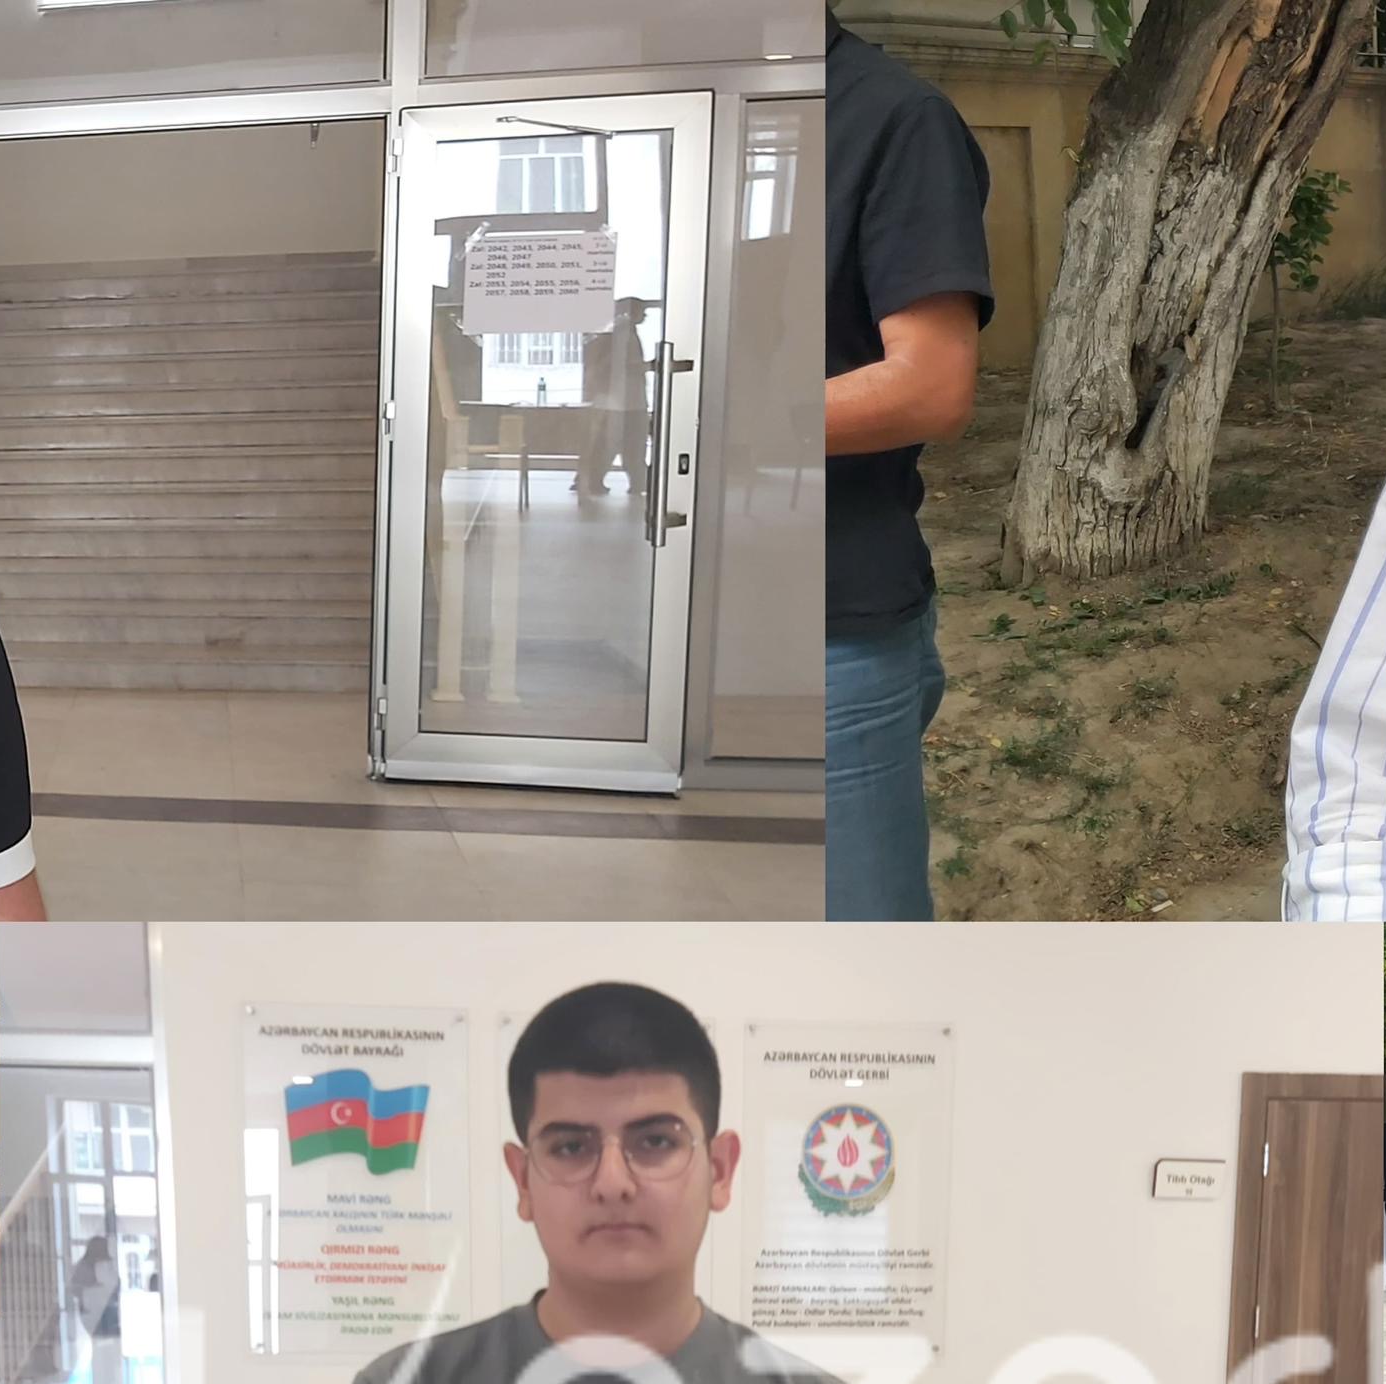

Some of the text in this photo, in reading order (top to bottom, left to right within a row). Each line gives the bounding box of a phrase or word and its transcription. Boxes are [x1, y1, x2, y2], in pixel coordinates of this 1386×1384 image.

[259, 1025, 445, 1041] AZƏRBAYCAN RESPUBLİKASININ
[302, 1043, 404, 1057] DÖVLƏT BAYRAĞI
[763, 1052, 936, 1065] AZƏRBAYCAN RESPUBLİKASININ
[810, 1067, 890, 1081] DÖVLƏT GERBİ
